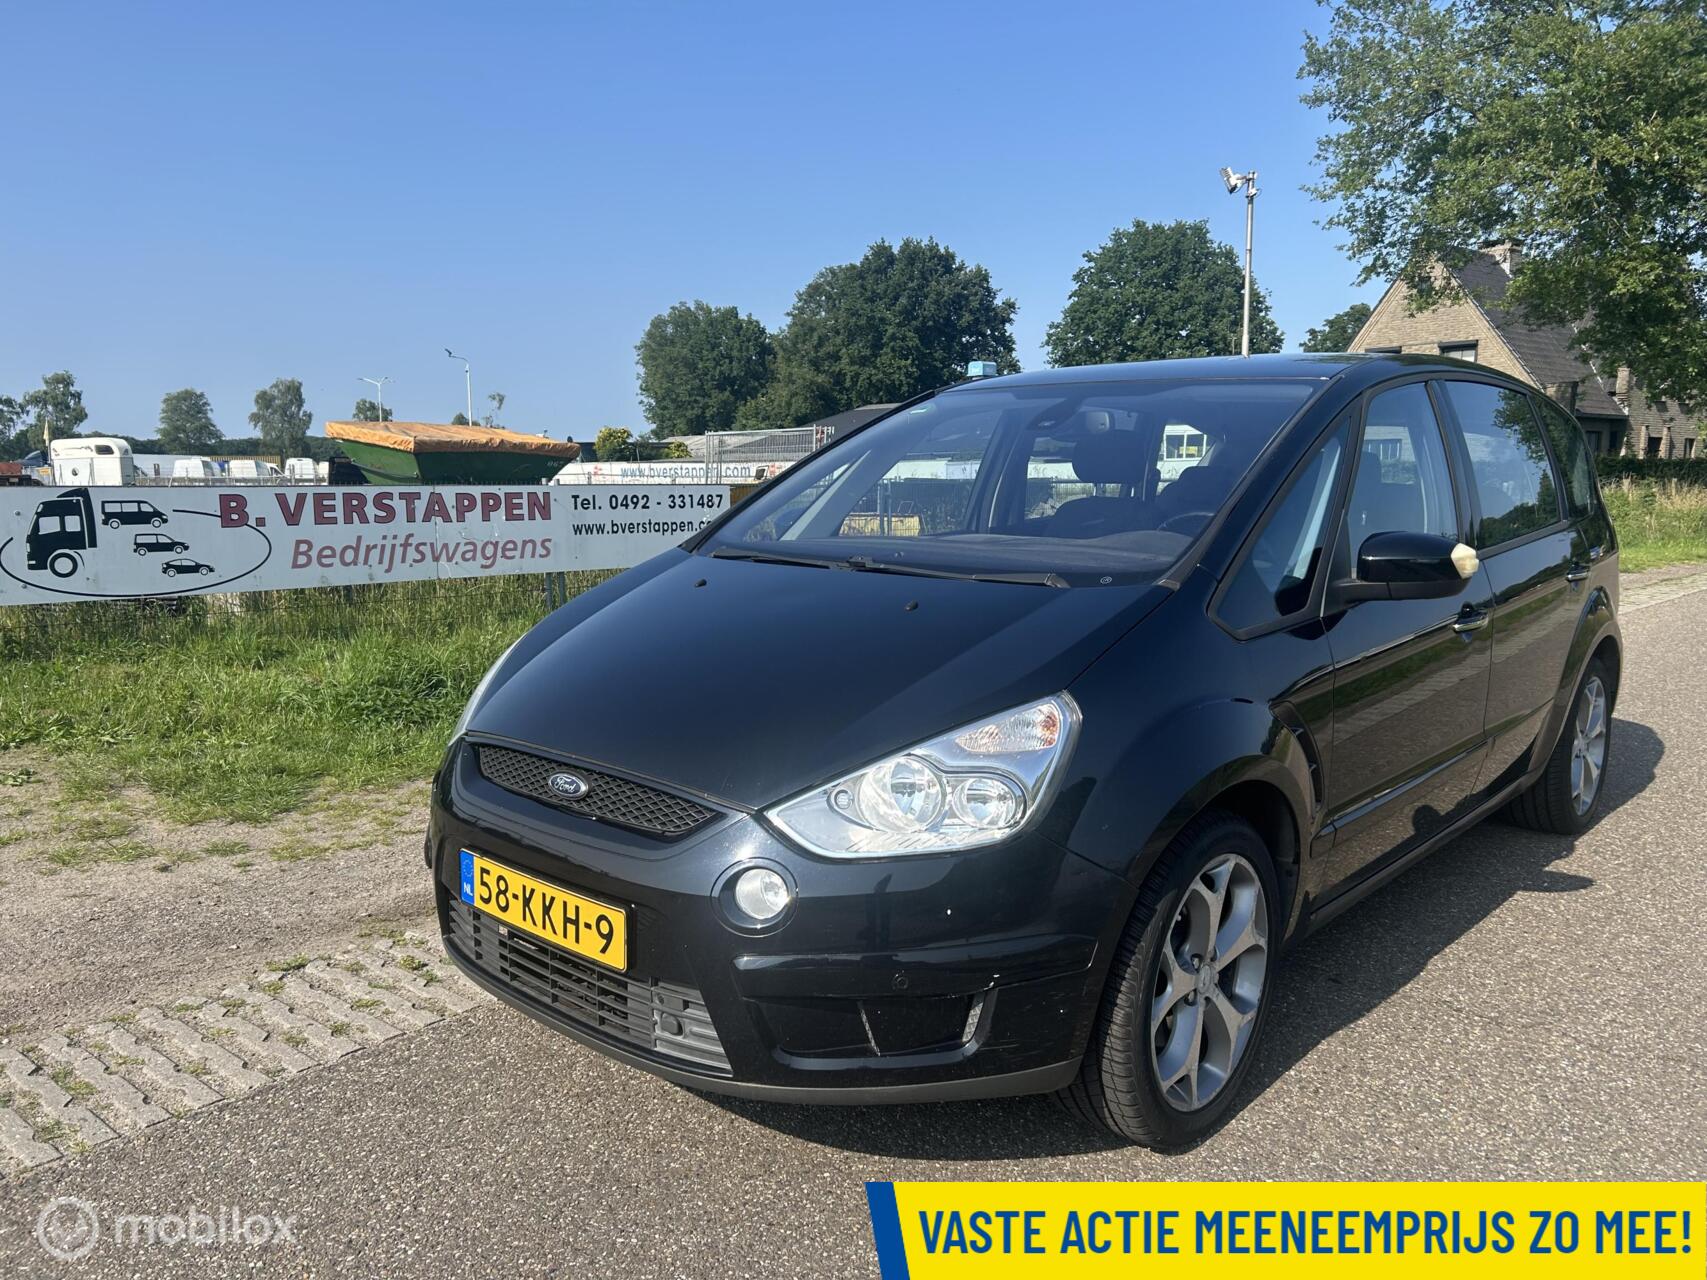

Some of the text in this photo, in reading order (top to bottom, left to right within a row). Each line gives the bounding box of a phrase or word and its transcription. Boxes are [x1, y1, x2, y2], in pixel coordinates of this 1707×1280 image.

[572, 494, 602, 511] Tel.
[609, 494, 651, 510] 0492
[668, 494, 723, 509] 331487
[291, 534, 552, 573] Bedrijfswagens
[551, 773, 581, 794] Ford
[463, 881, 474, 897] NL
[479, 867, 615, 955] 58-KKH-9
